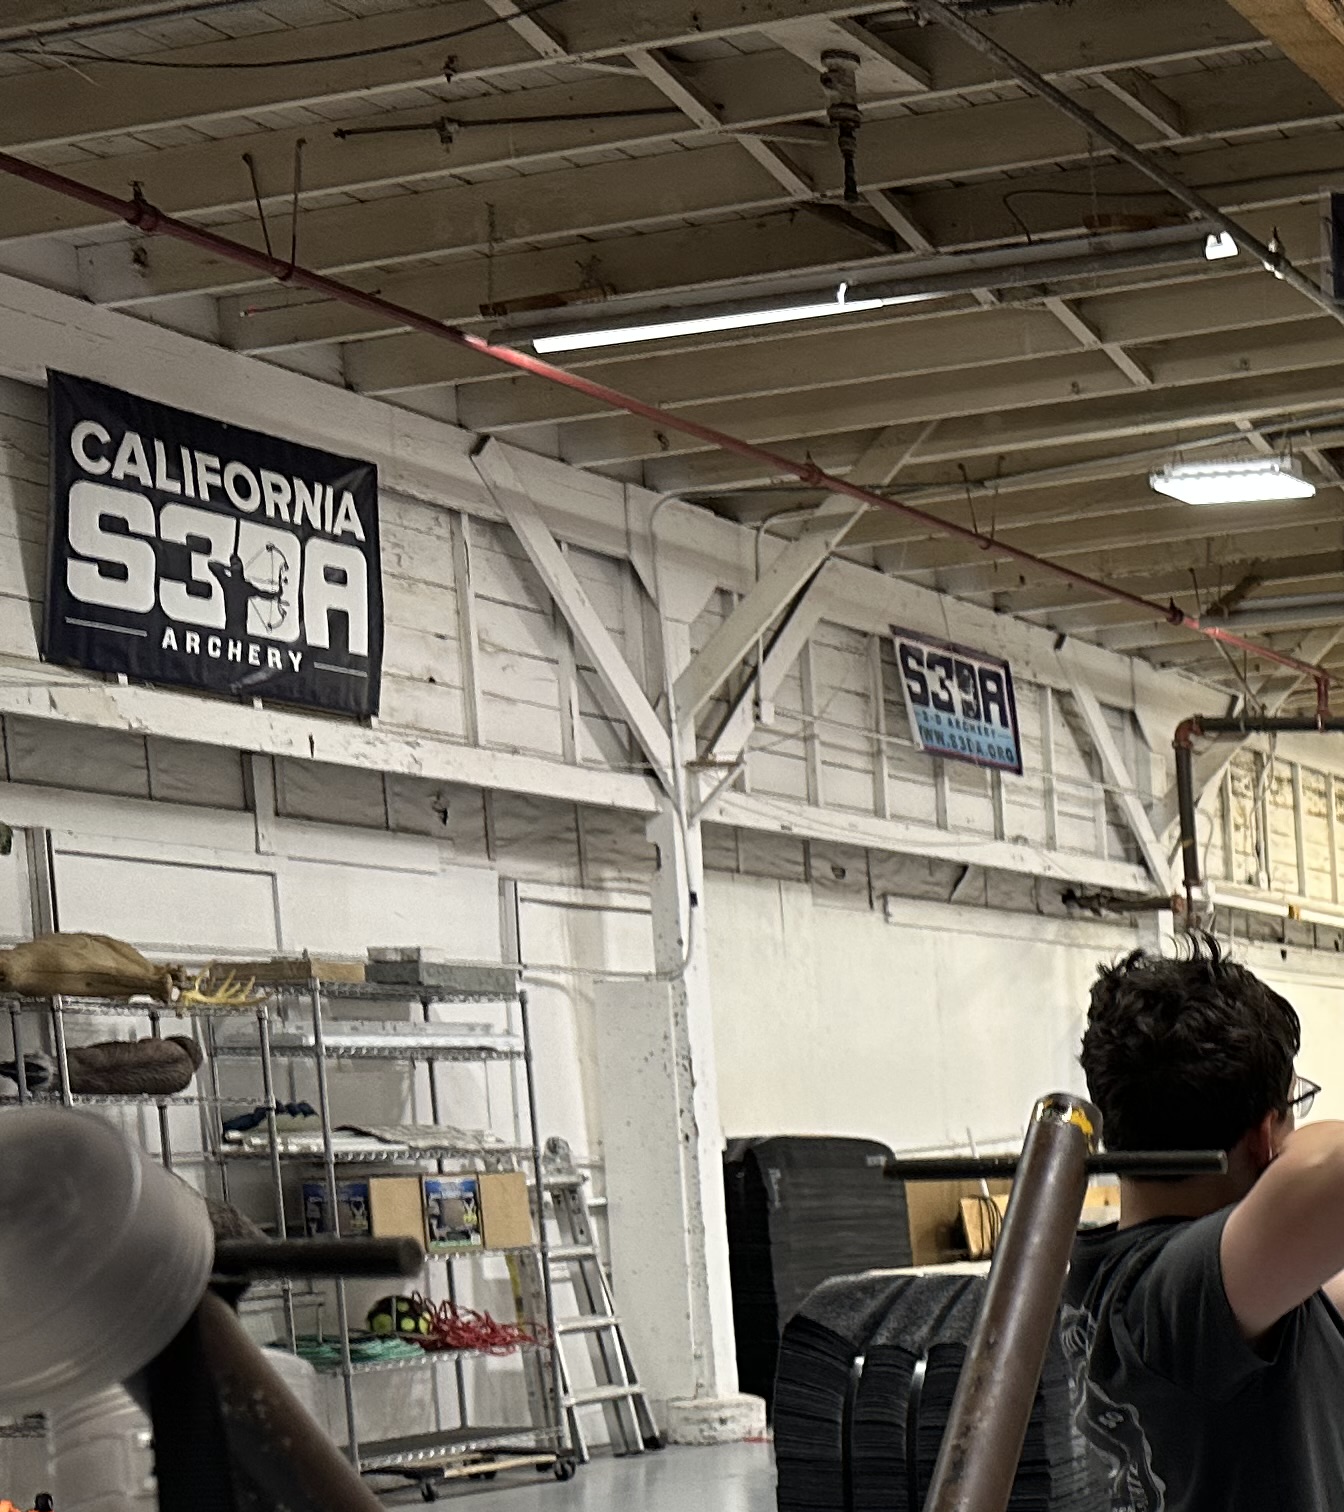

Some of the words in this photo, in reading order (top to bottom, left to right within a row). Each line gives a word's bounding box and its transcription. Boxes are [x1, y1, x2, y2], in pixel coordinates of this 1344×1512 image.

[71, 420, 366, 542] CALIFORNIA
[66, 480, 369, 655] S3DA
[161, 628, 304, 673] ARCHERY
[899, 644, 1010, 728] S3DA
